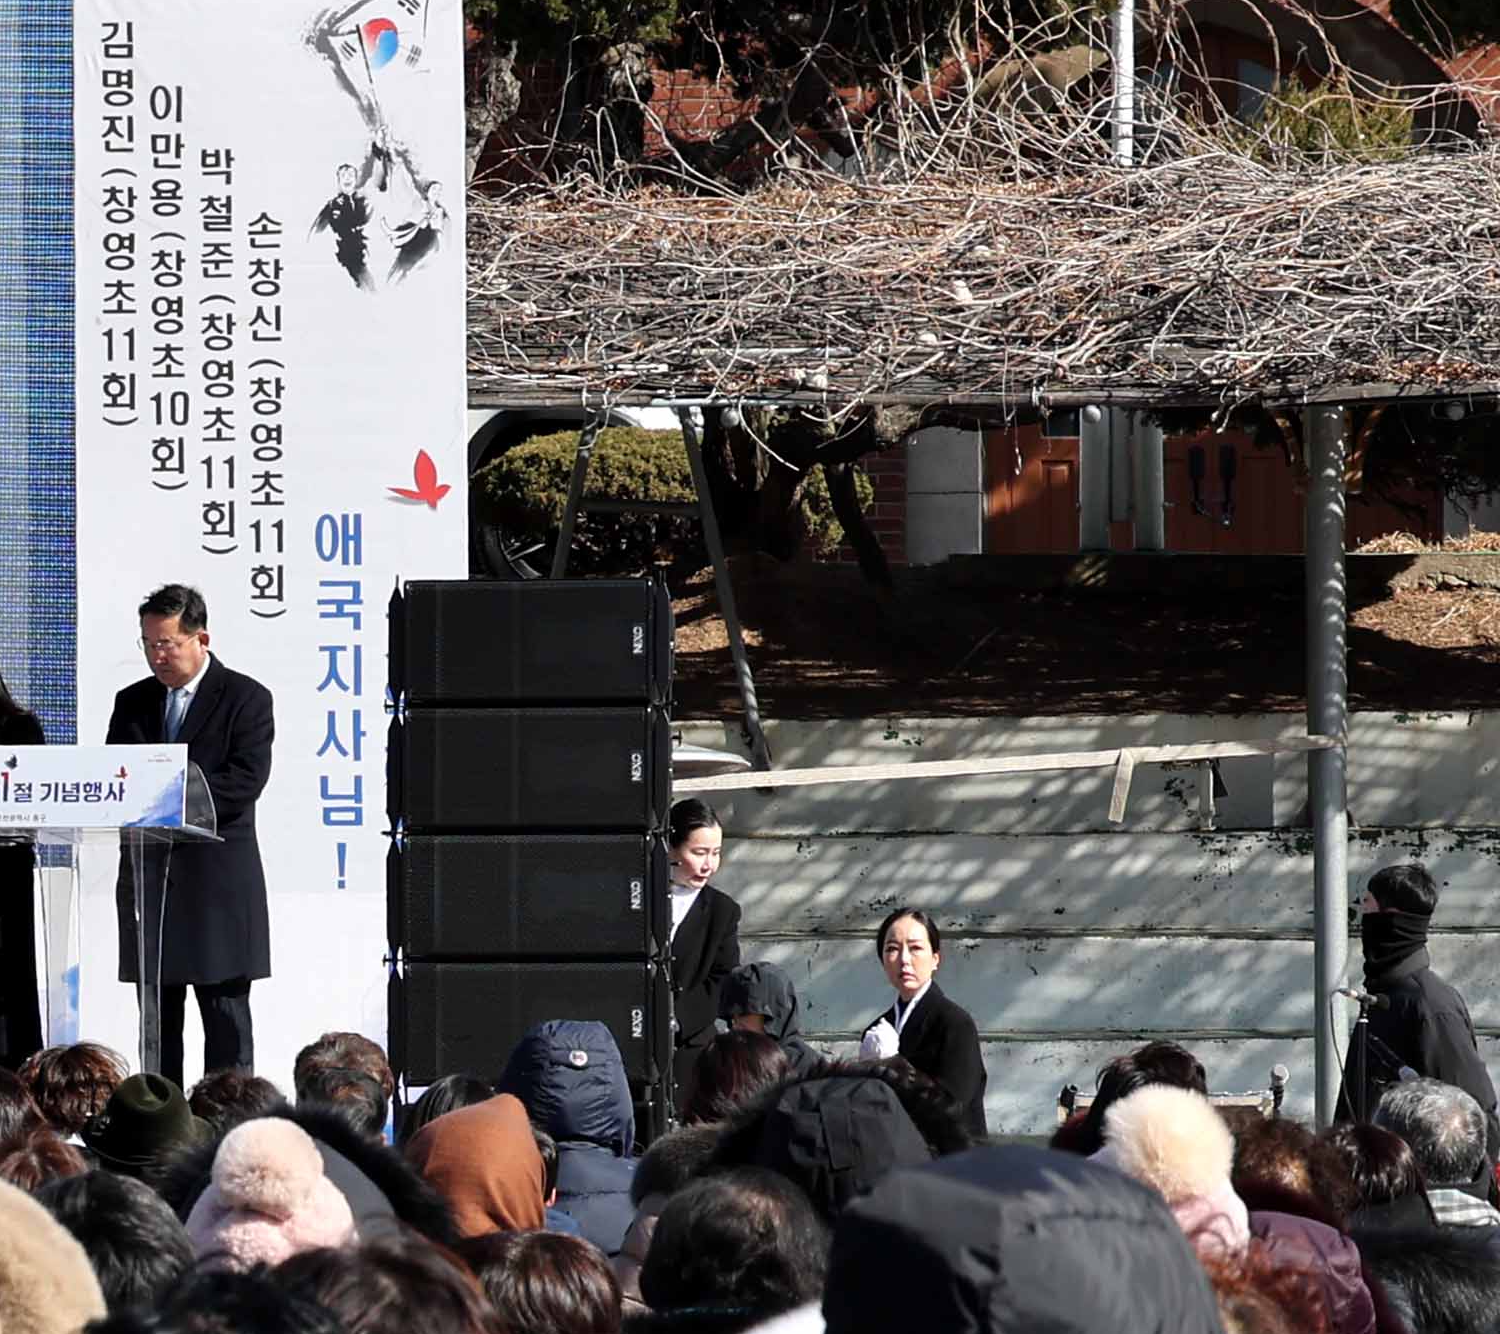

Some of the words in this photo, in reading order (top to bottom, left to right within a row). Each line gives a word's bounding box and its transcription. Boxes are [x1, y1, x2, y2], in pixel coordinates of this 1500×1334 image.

[632, 625, 644, 655] NEXO
[314, 512, 367, 890] 애국지사님!
[631, 752, 643, 782] NEXO
[39, 780, 126, 803] 기념행사
[630, 880, 642, 910] NEXO
[631, 1008, 643, 1038] NEXO
